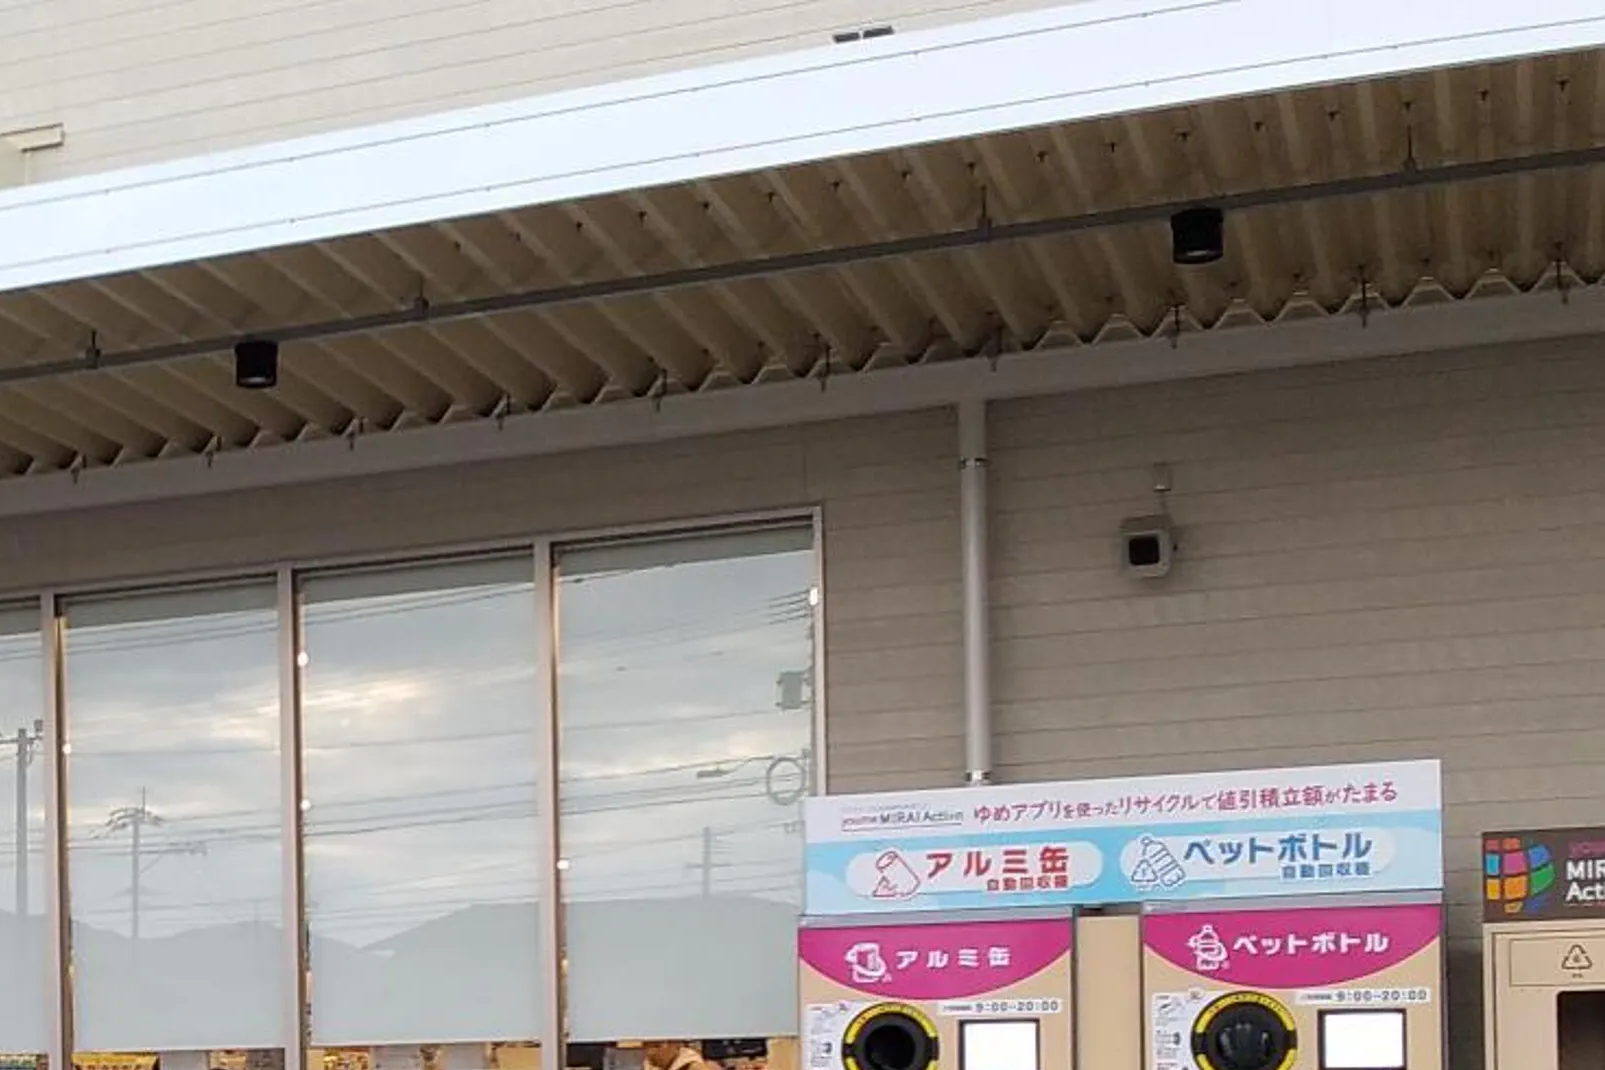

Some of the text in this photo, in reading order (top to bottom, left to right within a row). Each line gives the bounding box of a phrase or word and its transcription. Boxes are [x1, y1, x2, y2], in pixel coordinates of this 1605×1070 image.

[1184, 832, 1372, 864] ペットボトル
[926, 846, 1069, 878] アルミ缶
[1232, 932, 1389, 955] ペットボトル
[896, 947, 1010, 970] アルミ缶
